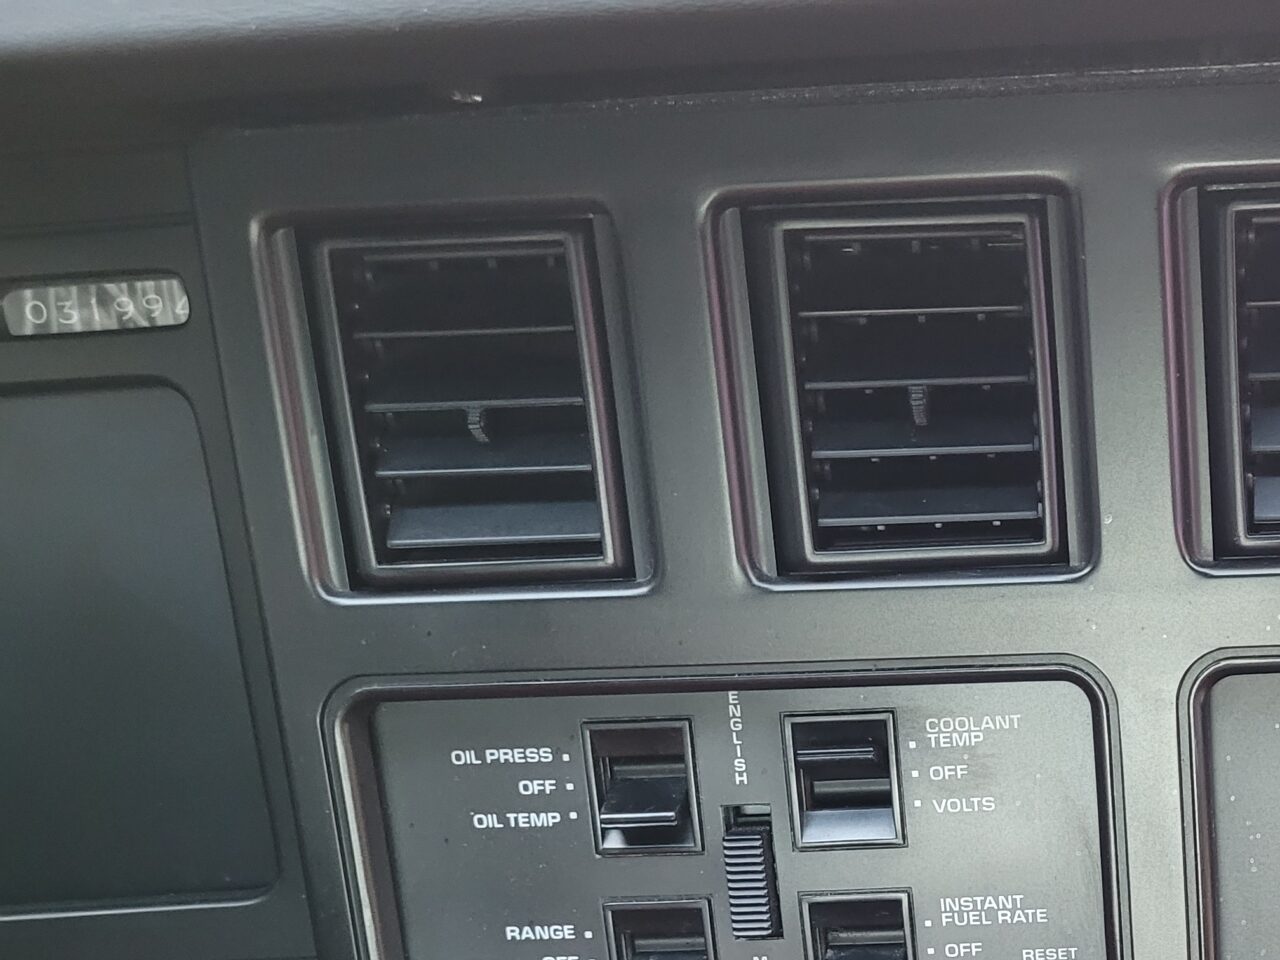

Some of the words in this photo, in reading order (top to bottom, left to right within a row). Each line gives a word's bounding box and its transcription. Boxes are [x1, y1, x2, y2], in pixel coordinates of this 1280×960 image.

[925, 714, 1021, 732] COOLANT
[728, 691, 748, 784] ENGLISH
[928, 731, 984, 748] TEMP
[451, 750, 481, 765] OIL
[486, 748, 553, 764] PRESS
[929, 764, 968, 781] OFF
[518, 780, 556, 795] OFF
[932, 796, 995, 813] VOLTS
[473, 813, 504, 829] OIL
[508, 812, 561, 828] TEMP
[940, 894, 1024, 912] INSTANT
[941, 910, 992, 926] FUEL
[998, 908, 1048, 924] RATE
[505, 925, 576, 940] RANGE
[944, 942, 983, 958] OFF
